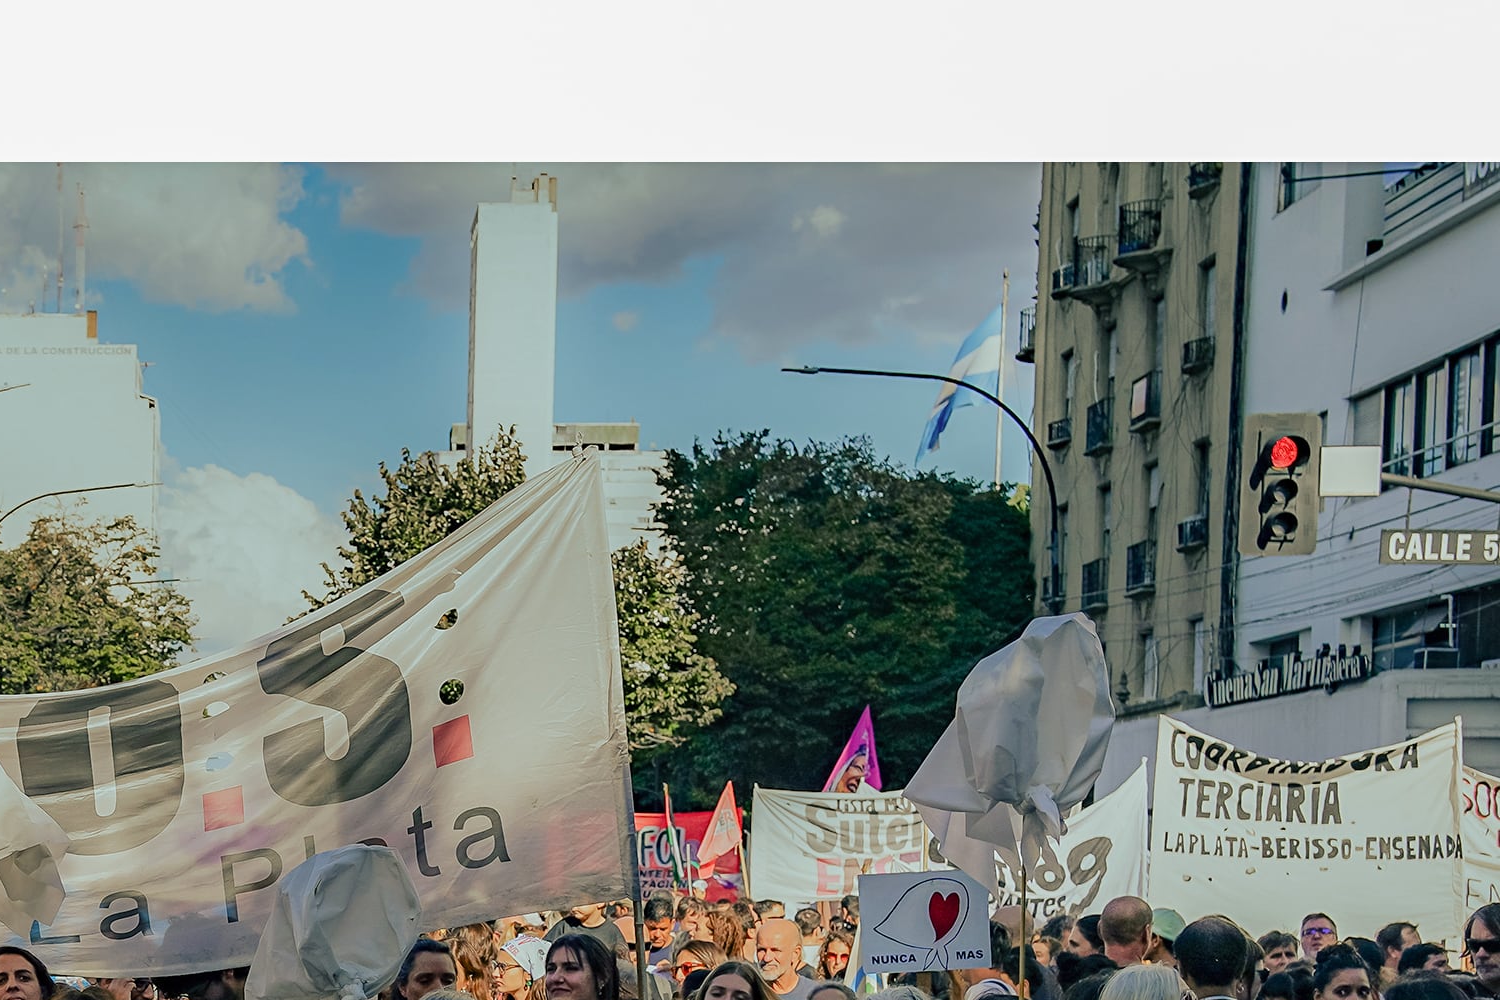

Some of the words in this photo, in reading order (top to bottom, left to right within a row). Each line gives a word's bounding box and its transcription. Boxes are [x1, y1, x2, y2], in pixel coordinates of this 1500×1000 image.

[6, 346, 21, 355] DE
[23, 346, 38, 355] LA
[1388, 532, 1472, 561] CALLE
[1483, 533, 1500, 562] 5
[1203, 672, 1250, 707] Cinema
[871, 954, 917, 965] NUNCA
[956, 950, 984, 960] MAS
